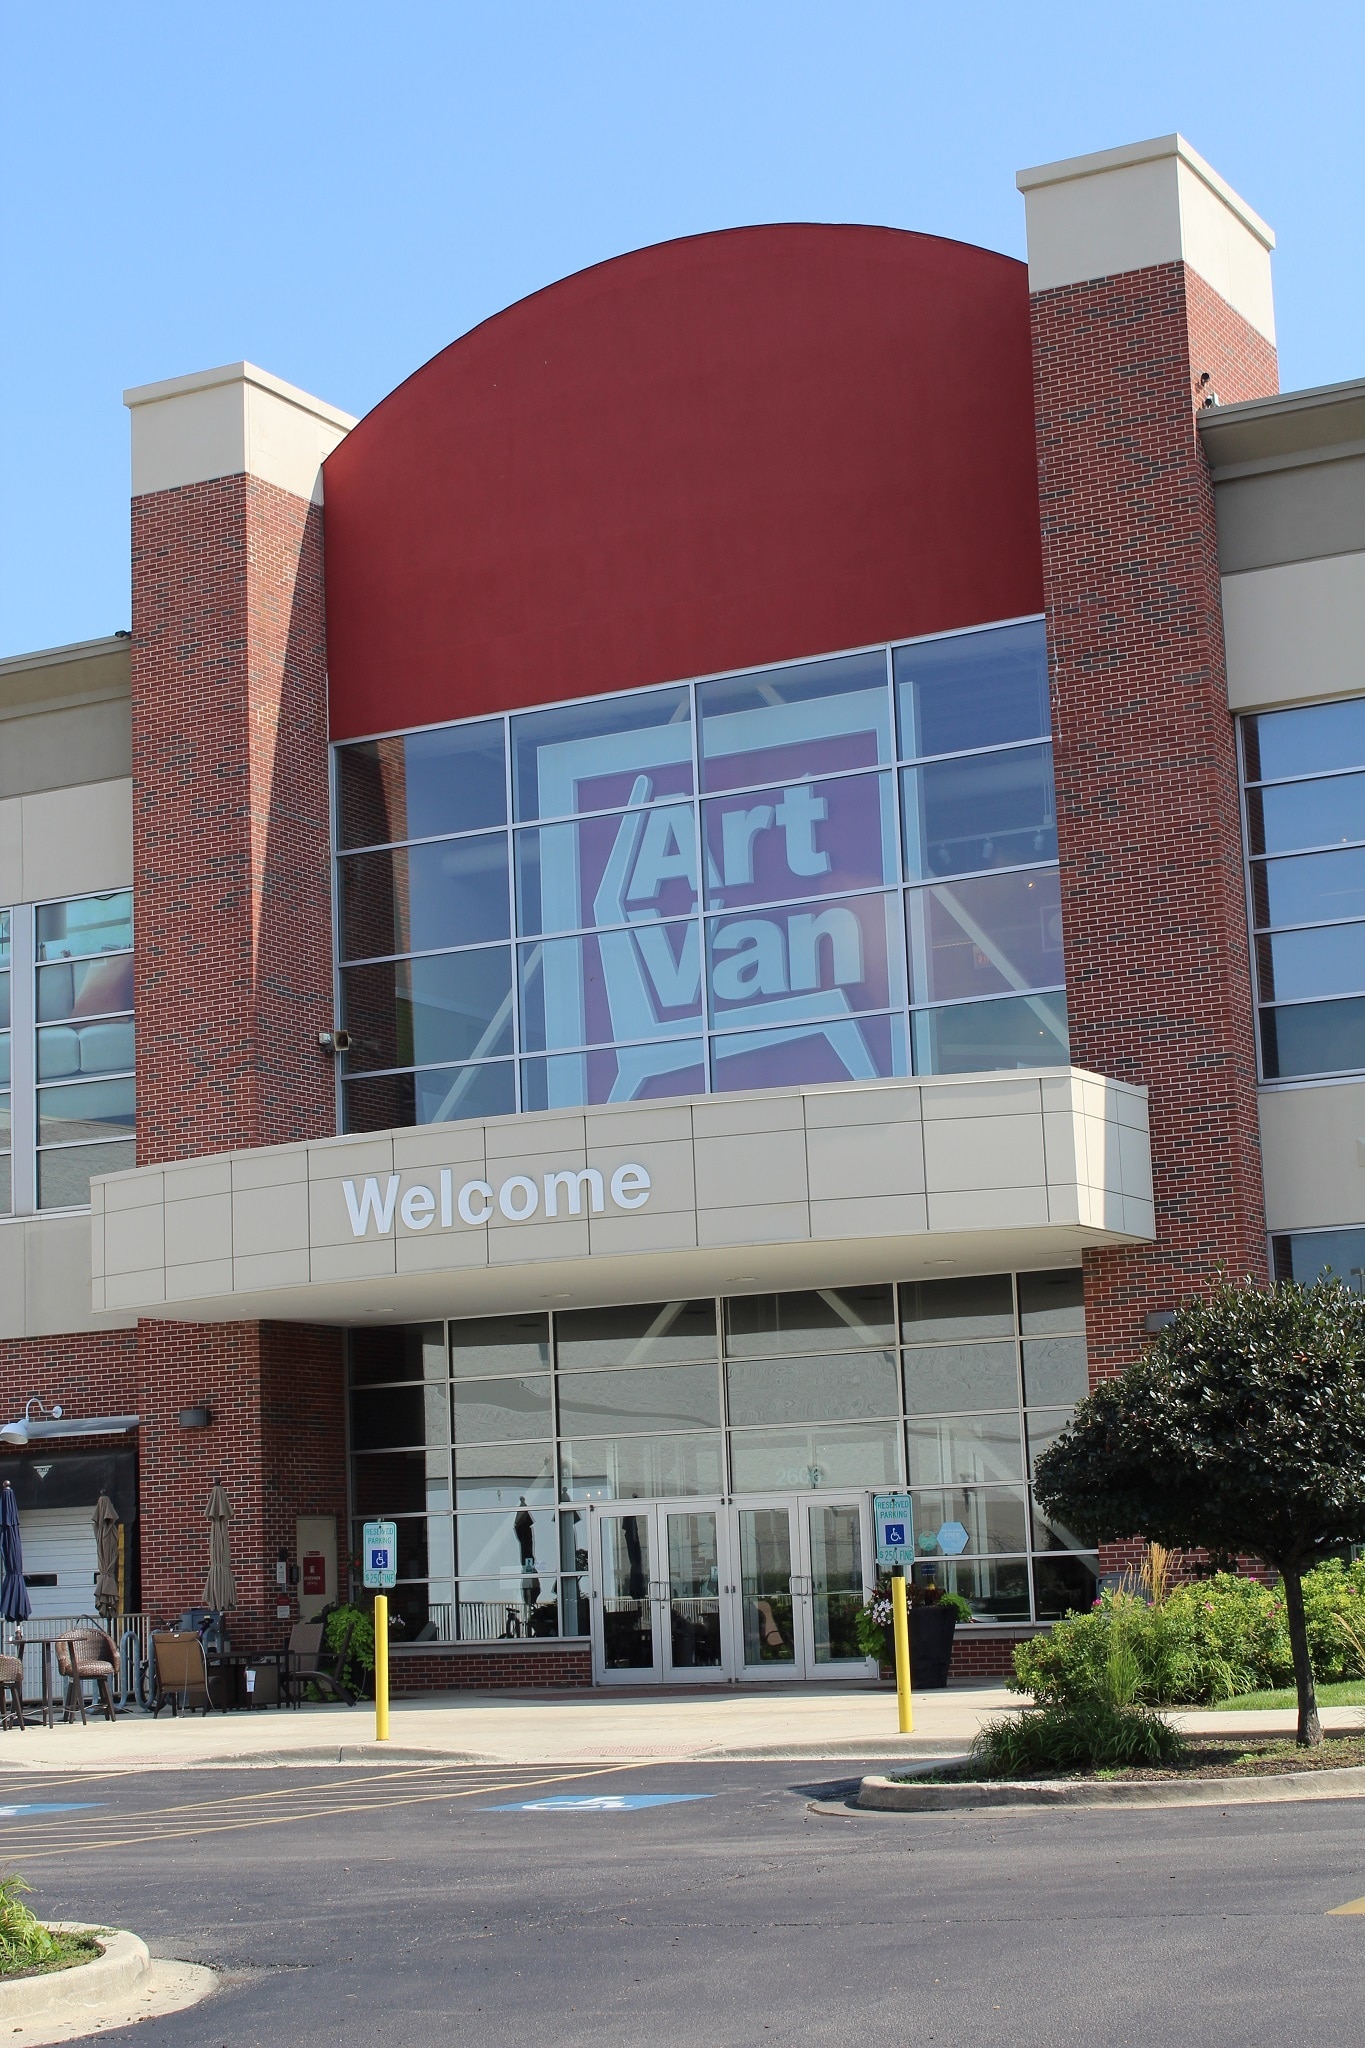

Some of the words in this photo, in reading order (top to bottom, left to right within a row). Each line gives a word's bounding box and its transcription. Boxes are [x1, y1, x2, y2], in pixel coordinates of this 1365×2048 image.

[625, 772, 833, 901] Art
[626, 899, 865, 1008] Van
[342, 1163, 651, 1237] Welcome
[878, 1501, 909, 1509] RESERVED
[880, 1511, 908, 1519] PARKING
[365, 1528, 394, 1536] RESERVED
[368, 1537, 392, 1545] PARKING
[900, 1549, 914, 1561] FINE
[382, 1573, 395, 1584] FINE
